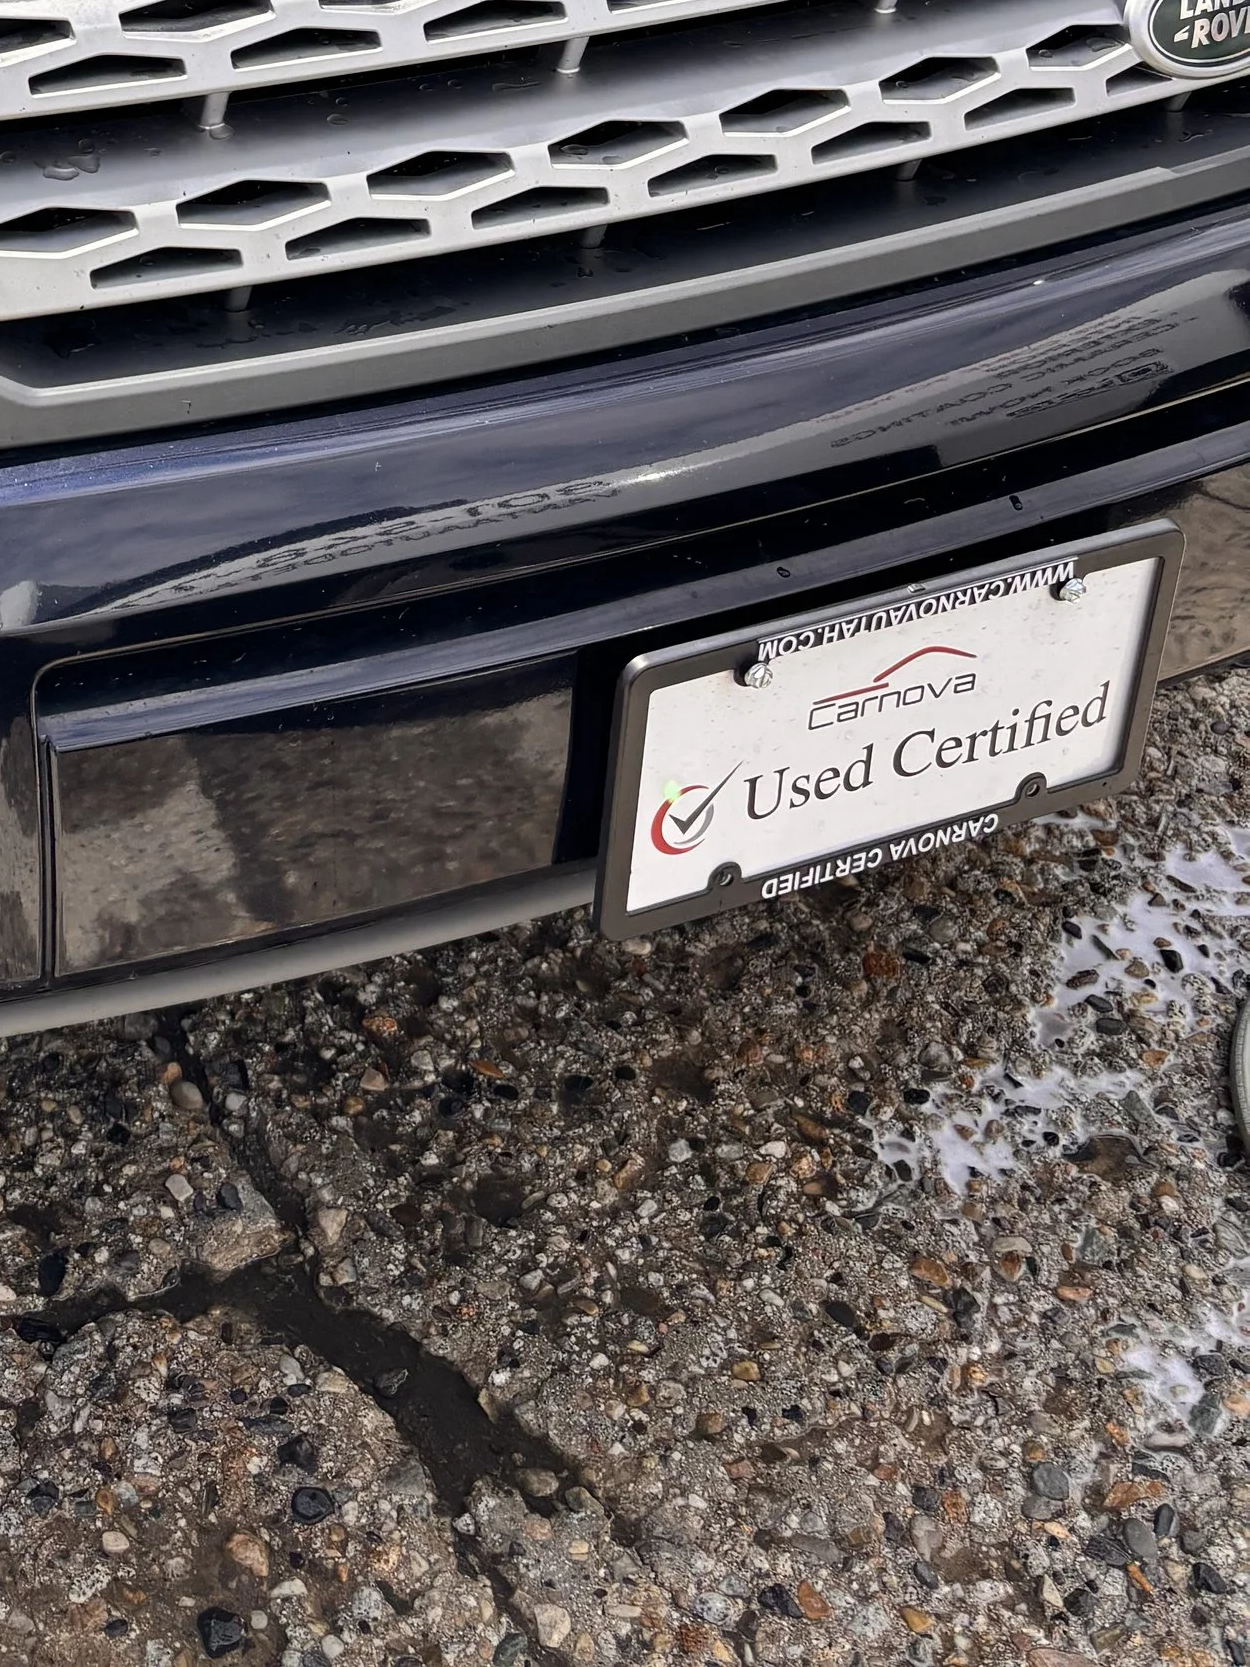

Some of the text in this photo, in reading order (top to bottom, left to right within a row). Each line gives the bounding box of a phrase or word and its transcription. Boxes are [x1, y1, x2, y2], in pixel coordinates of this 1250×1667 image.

[757, 561, 1075, 662] WWW.CARNOVAUTAH.COM
[807, 672, 977, 731] Carnova
[744, 680, 1111, 820] Used Certified
[761, 813, 999, 900] CARNOVA CERTIFIED
